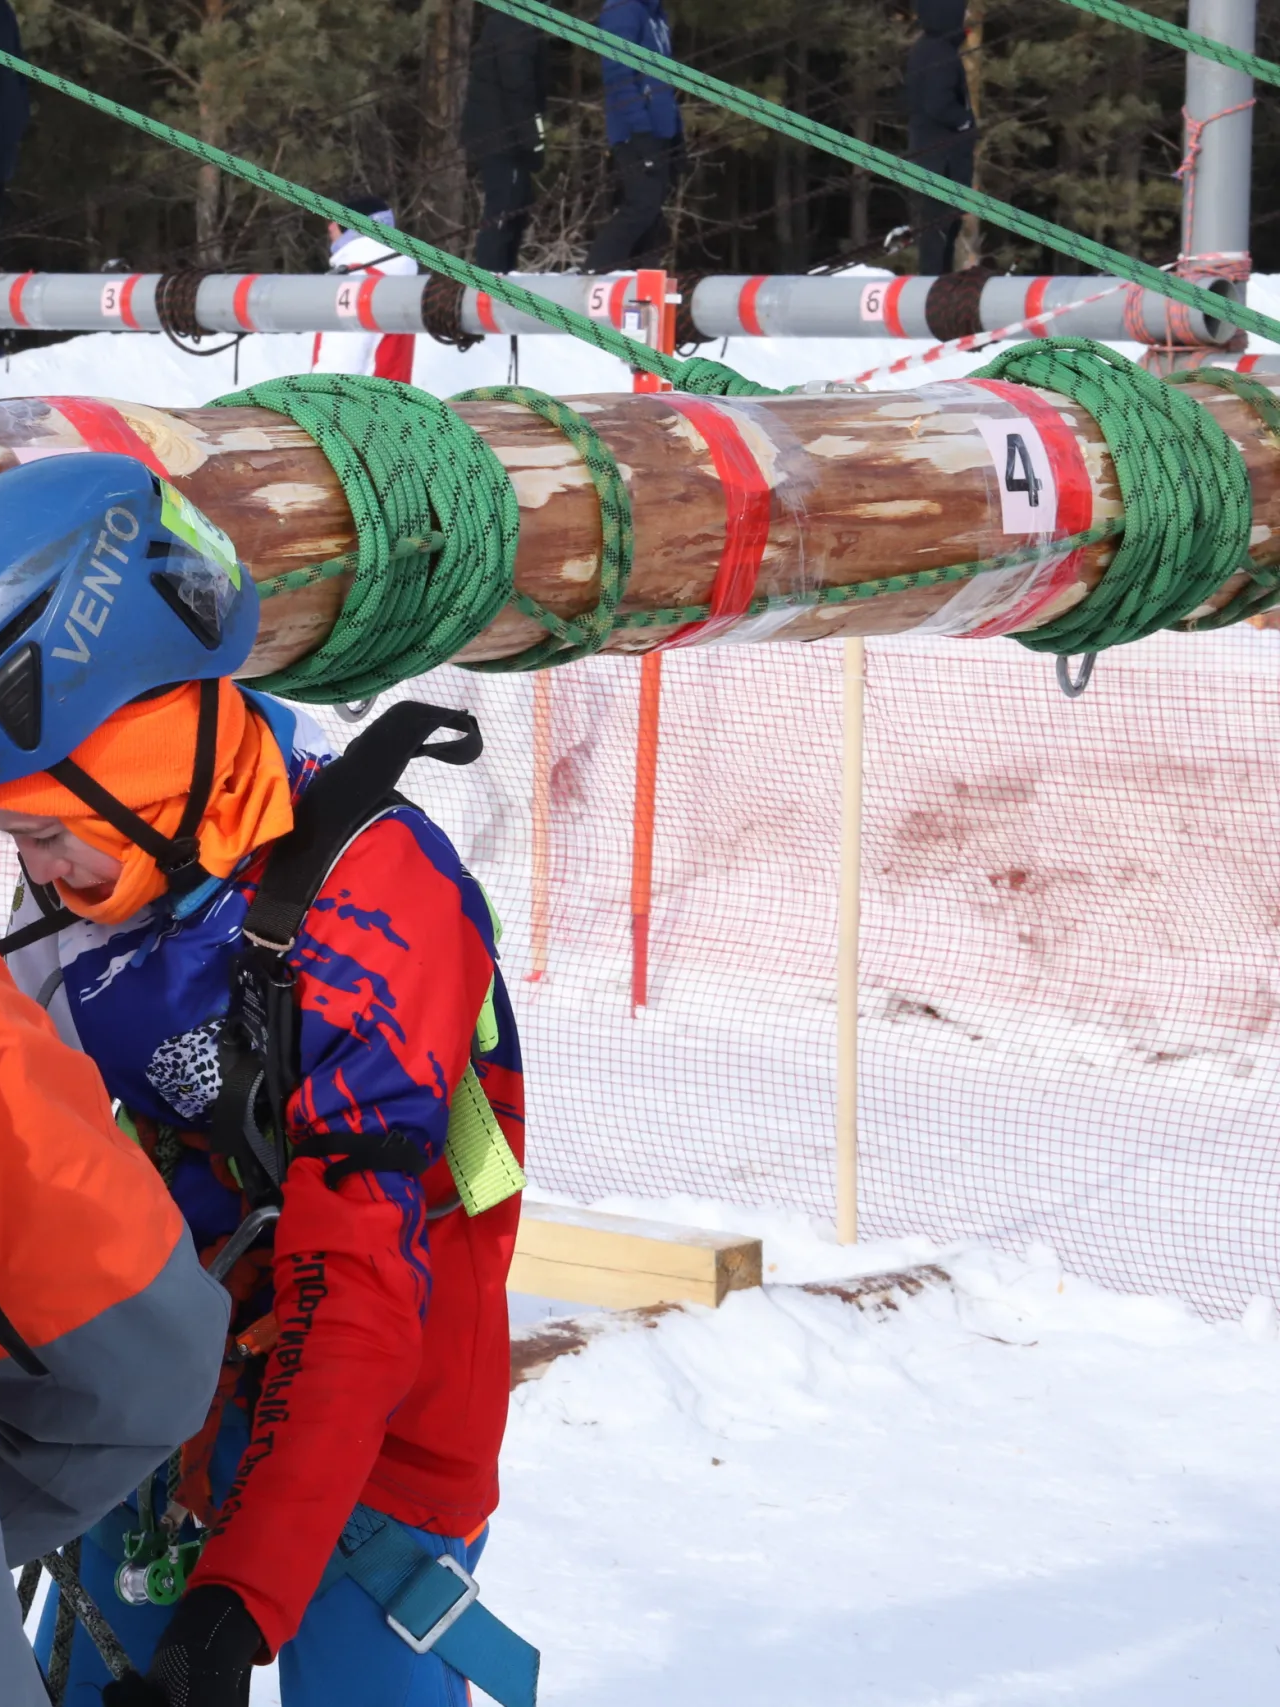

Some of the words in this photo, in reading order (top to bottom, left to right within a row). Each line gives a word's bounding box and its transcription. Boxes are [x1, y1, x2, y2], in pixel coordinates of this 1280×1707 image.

[104, 287, 116, 310] 3
[338, 288, 351, 310] 4
[590, 287, 605, 310] 5
[866, 289, 881, 313] 6
[1004, 433, 1043, 508] 4
[51, 506, 140, 664] VENTO
